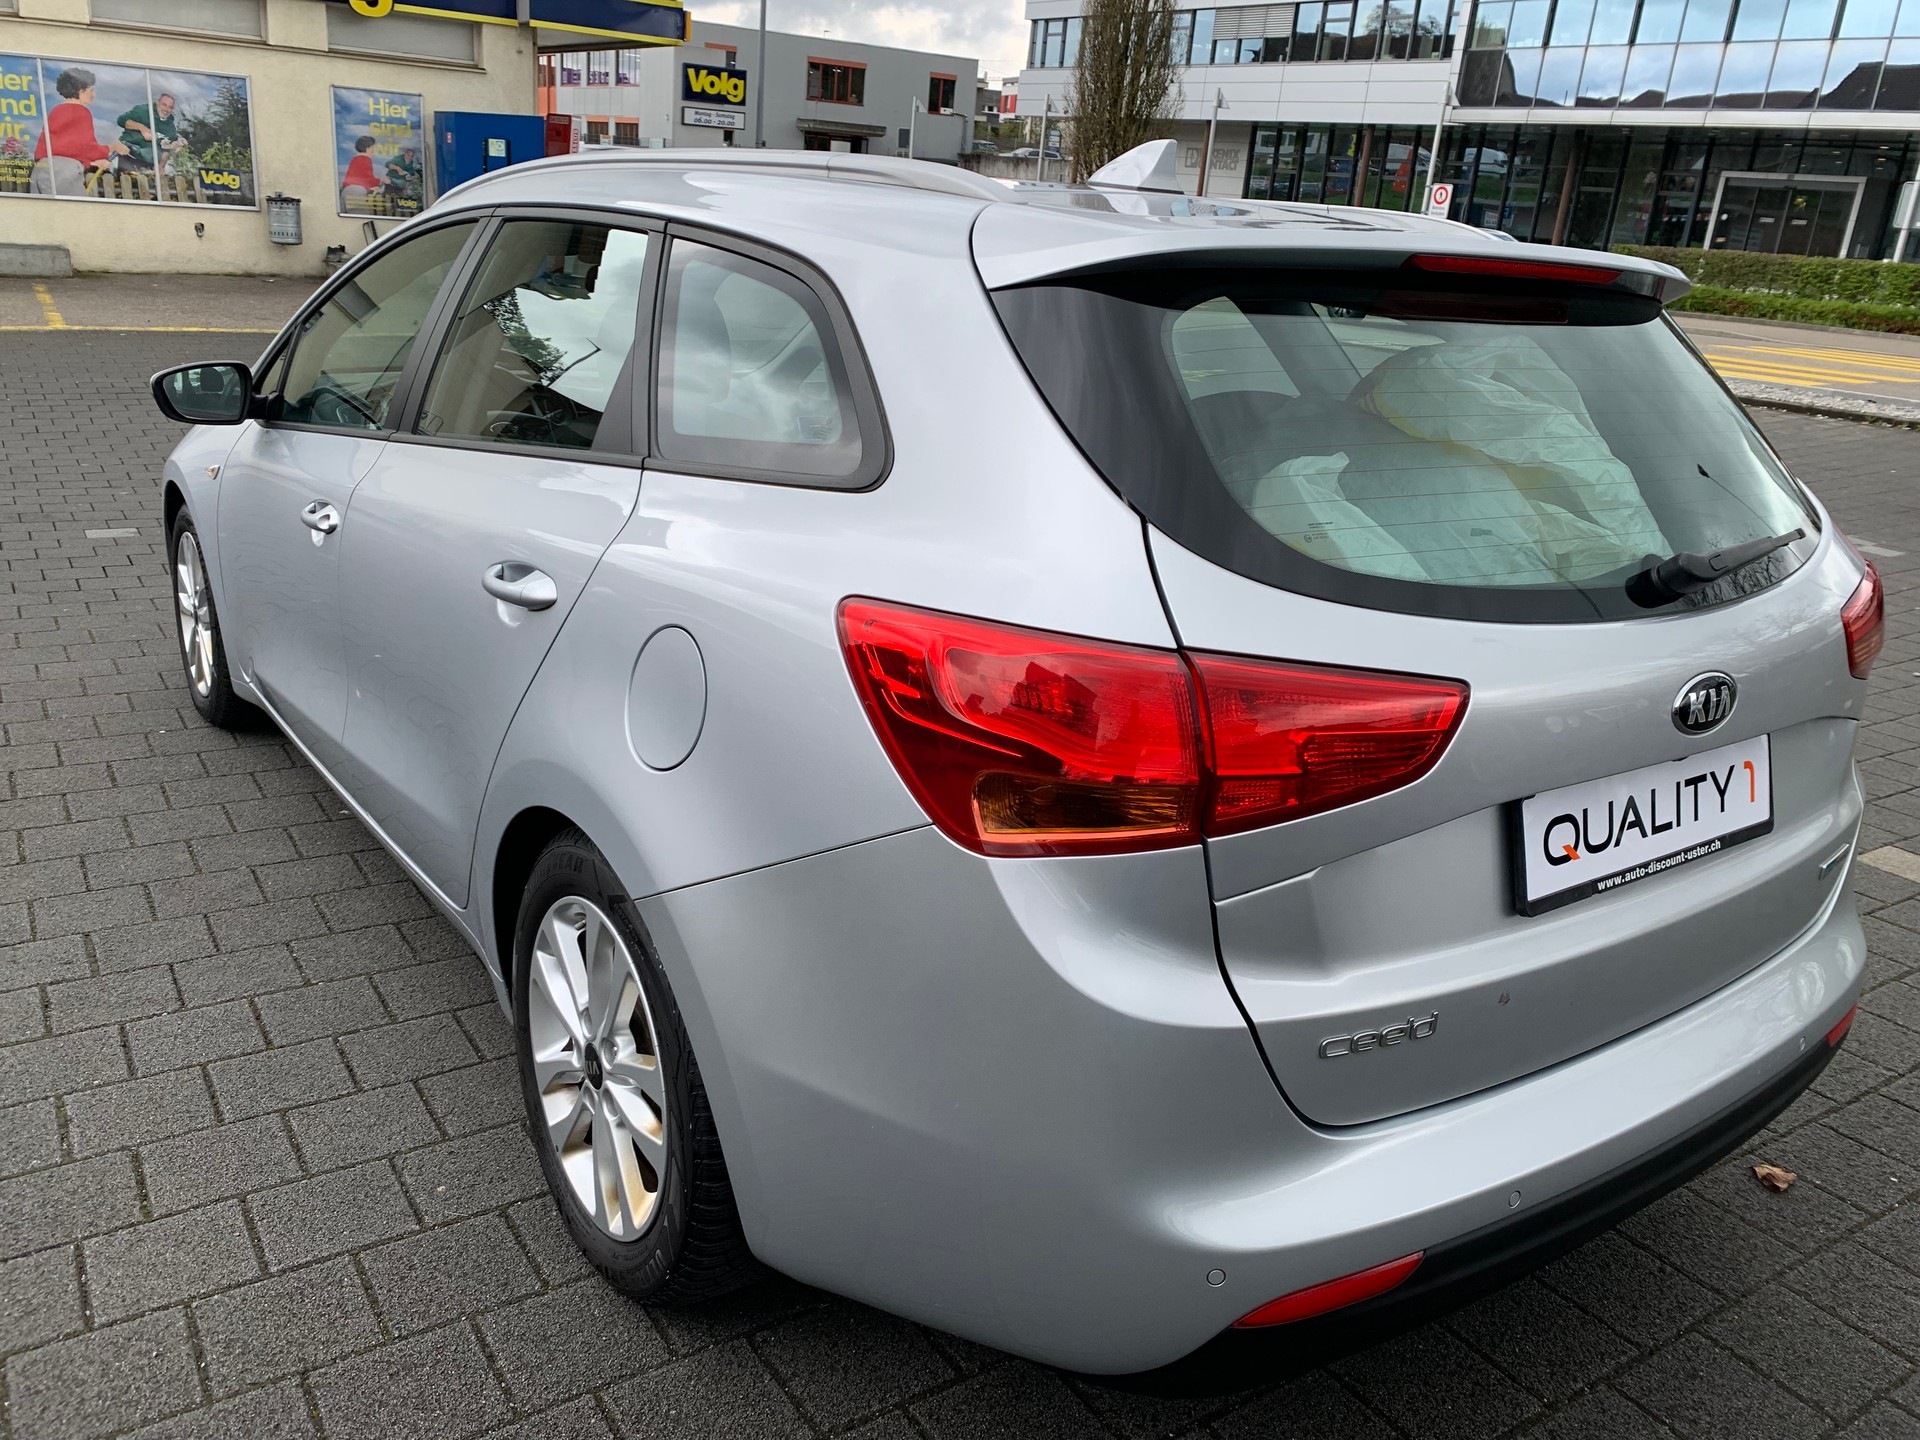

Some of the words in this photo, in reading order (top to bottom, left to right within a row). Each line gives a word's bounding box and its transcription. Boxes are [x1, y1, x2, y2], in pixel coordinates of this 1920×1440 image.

[0, 67, 33, 91] ier
[686, 68, 745, 103] Volg
[1, 94, 37, 117] nd
[368, 97, 410, 119] Hier
[0, 116, 30, 141] ir.
[369, 117, 412, 139] sind
[693, 117, 712, 125] 06.00
[200, 169, 241, 190] Volg
[1687, 685, 1731, 725] KIA
[1596, 839, 1721, 891] www.auto-discount-uster.ch
